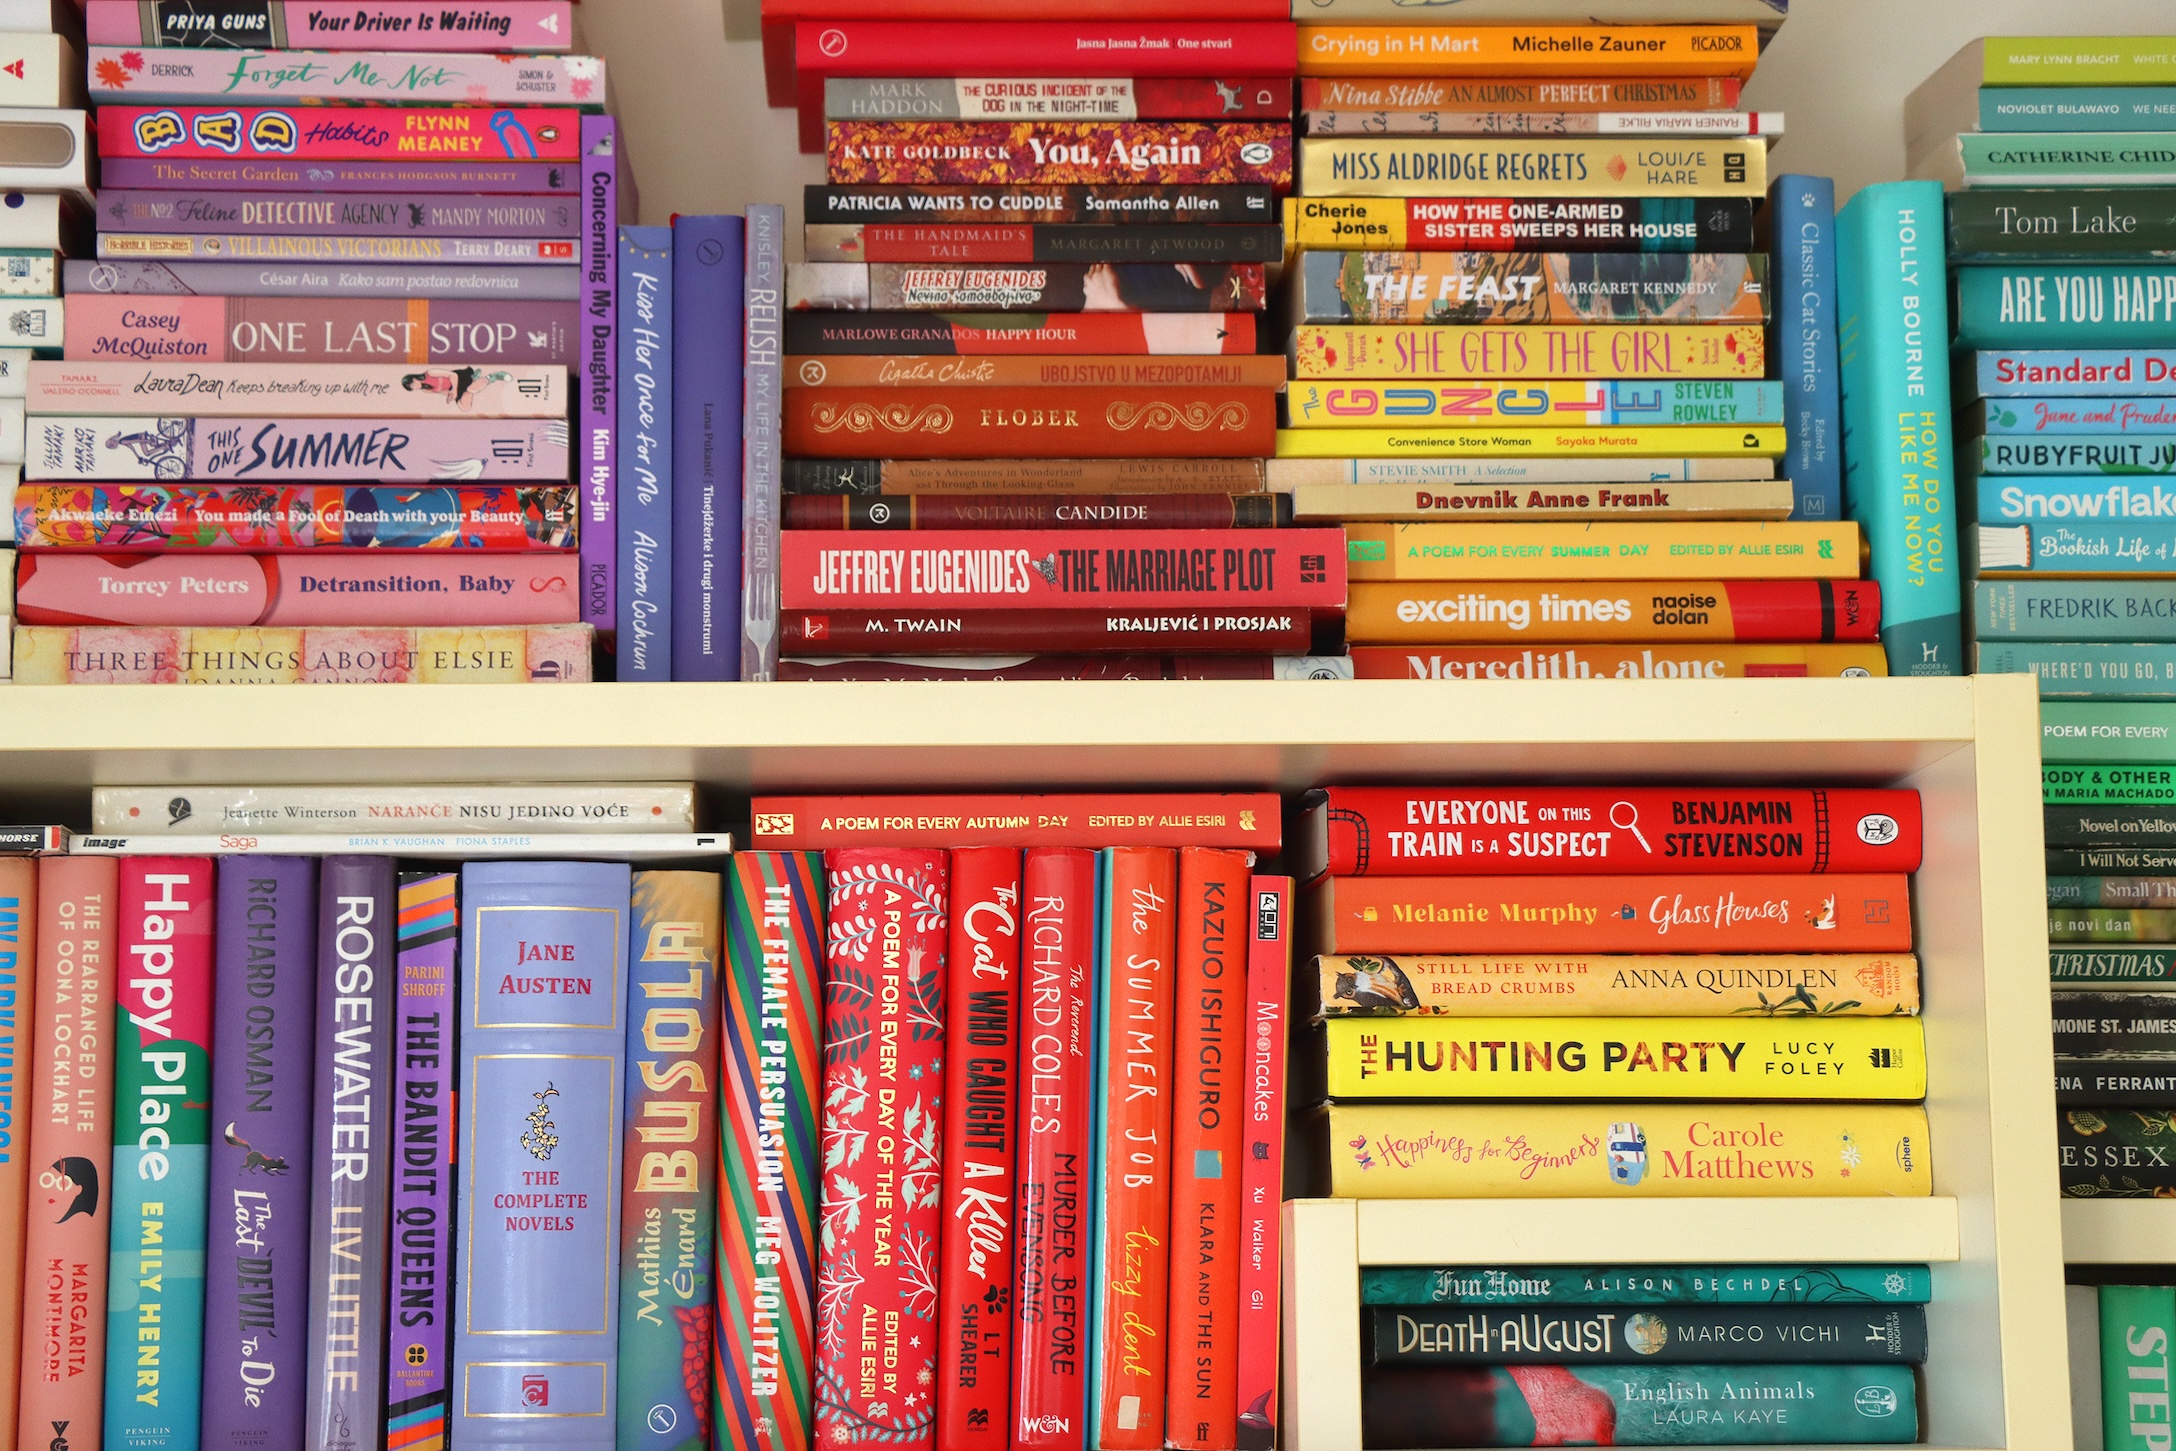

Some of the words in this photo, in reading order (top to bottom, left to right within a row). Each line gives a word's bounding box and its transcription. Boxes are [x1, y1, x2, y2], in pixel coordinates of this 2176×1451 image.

[166, 15, 213, 31] PRIYA
[221, 13, 266, 30] GUNS
[308, 12, 350, 31] Your
[354, 13, 412, 32] Driver
[417, 13, 432, 31] Is
[438, 12, 511, 36] Waiting
[1076, 38, 1106, 50] Jasna
[1108, 38, 1137, 50] Jasna
[1139, 37, 1169, 49] Žmak
[1177, 38, 1198, 48] One
[1201, 38, 1232, 49] stvari
[1311, 36, 1379, 55] Crying
[1385, 36, 1404, 52] in
[1409, 37, 1424, 52] H
[1431, 36, 1479, 52] Mart
[1512, 36, 1594, 52] Michelle
[1599, 37, 1666, 52] Zauner
[1691, 37, 1742, 51] PICADOR
[2009, 55, 2040, 64] MARY
[2043, 55, 2072, 64] LYNN
[2076, 55, 2119, 64] BRACHT
[152, 65, 194, 77] DERRICK
[518, 70, 543, 80] SIMON
[516, 81, 556, 92] SCHUSTER
[963, 84, 980, 97] THE
[984, 83, 1037, 97] CURIOUS
[1042, 84, 1092, 97] INCIDENT
[1096, 84, 1108, 96] OF
[1110, 84, 1127, 96] THE
[982, 100, 1005, 113] DOG
[1010, 101, 1021, 112] IN
[1025, 100, 1046, 112] THE
[1050, 100, 1120, 112] NIGHT-TIME
[1998, 105, 2054, 113] NOVIOLET
[2058, 105, 2119, 114] BULAWAYO
[1333, 153, 1380, 180] MISS
[1387, 153, 1489, 180] ALDRIDGE
[1496, 153, 1588, 180] REGRETS
[1988, 150, 2114, 164] CATHERINE
[154, 166, 185, 180] The
[190, 166, 236, 182] Secret
[242, 166, 298, 182] Garden
[340, 171, 393, 180] FRANCES
[398, 171, 453, 181] HODGSON
[458, 170, 518, 181] BURNETT
[1647, 170, 1698, 185] HARE
[828, 195, 902, 211] PATRICIA
[907, 196, 964, 211] WANTS
[969, 196, 993, 210] TO
[999, 195, 1063, 211] CUDDLE
[1996, 207, 2058, 234] Tom
[2071, 206, 2136, 234] Lake
[1898, 209, 1918, 286] HOLLY
[260, 273, 296, 287] César
[301, 274, 328, 286] Aira
[338, 274, 372, 288] Kako
[376, 277, 403, 287] sam
[406, 276, 451, 291] postao
[455, 274, 518, 289] redovnica
[2000, 277, 2046, 322] ARE
[2055, 276, 2102, 322] YOU
[231, 321, 305, 351] ONE
[325, 321, 417, 350] LAST
[430, 321, 517, 351] STOP
[1903, 295, 1924, 396] BOURNE
[1996, 358, 2131, 382] Standard
[1675, 383, 1733, 399] STEVEN
[980, 409, 1079, 426] FLOBER
[1673, 405, 1737, 421] ROWLEY
[1388, 437, 1455, 446] Convenience
[1459, 437, 1487, 447] Store
[1491, 437, 1532, 447] Woman
[1556, 436, 1595, 448] Sayaka
[1599, 436, 1638, 446] Murata
[1997, 444, 2142, 466] RUBYFRUIT
[1416, 491, 1517, 509] Dnevnik
[1527, 491, 1590, 508] Anne
[1598, 488, 1669, 508] Frank
[813, 549, 903, 594] JEFFREY
[910, 548, 1030, 594] EUGENIDES
[1059, 549, 1099, 592] THE
[1106, 549, 1218, 592] MARRIAGE
[1223, 549, 1276, 590] PLOT
[299, 574, 448, 595] Detransition,
[459, 574, 514, 594] Baby
[2027, 599, 2118, 619] FREDRIK
[1106, 614, 1199, 633] KRALJEVIĆ
[1203, 618, 1210, 632] I
[1215, 617, 1292, 632] PROSJAK
[2044, 726, 2087, 737] POEM
[2092, 726, 2121, 737] FOR
[2125, 726, 2168, 738] EVERY
[223, 805, 278, 821] Jeanette
[284, 805, 357, 819] Winterson
[367, 801, 452, 818] NARANČE
[460, 805, 502, 818] NISU
[508, 805, 576, 821] JEDINO
[581, 801, 629, 818] VOĆE
[1406, 800, 1530, 824] EVERYONE
[1538, 808, 1558, 820] ON
[1562, 807, 1592, 821] THIS
[1672, 802, 1792, 824] BENJAMIN
[2080, 819, 2119, 833] Novel
[2121, 821, 2139, 832] on
[83, 836, 127, 849] image
[220, 834, 258, 851] Saga
[348, 838, 376, 846] BRIAN
[380, 838, 390, 846] K.
[394, 838, 445, 846] VAUGHAN
[1388, 832, 1463, 857] TRAIN
[1471, 840, 1484, 853] IS
[1488, 840, 1498, 853] A
[1508, 832, 1610, 857] SUSPECT
[1664, 833, 1802, 857] STEVENSON
[2081, 854, 2084, 866] I
[2088, 854, 2113, 867] Will
[2116, 854, 2139, 866] Not
[1392, 903, 1489, 923] Melanie
[1499, 902, 1598, 927] Murphy
[1198, 881, 1225, 979] KAZUO
[129, 874, 190, 1039] Happy
[517, 941, 575, 963] JANE
[499, 977, 592, 995] AUSTEN
[1611, 969, 1688, 990] ANNA
[1696, 969, 1838, 992] QUINDLEN
[329, 896, 374, 1183] ROSEWATER
[1773, 1042, 1835, 1055] LUCY
[1198, 986, 1222, 1130] ISHIGURO
[1386, 1042, 1587, 1073] HUNTING
[1603, 1041, 1747, 1073] PARTY
[1765, 1062, 1845, 1075] FOLEY
[137, 1051, 186, 1181] Place
[2061, 1146, 2169, 1167] ESSEX
[523, 1171, 559, 1187] THE
[493, 1193, 587, 1208] COMPLETE
[505, 1216, 574, 1231] NOVELS
[1198, 1203, 1216, 1265] KLARA
[140, 1202, 163, 1292] EMILY
[1197, 1272, 1211, 1306] AND
[1584, 1279, 1673, 1291] ALISON
[1694, 1278, 1803, 1291] BECHDEL
[1196, 1312, 1214, 1345] THE
[136, 1303, 161, 1407] HENRY
[1196, 1356, 1213, 1398] SUN
[1625, 1382, 1710, 1405] English
[1721, 1381, 1815, 1400] Animals
[1654, 1410, 1726, 1425] LAURA
[1733, 1409, 1786, 1424] KAYE
